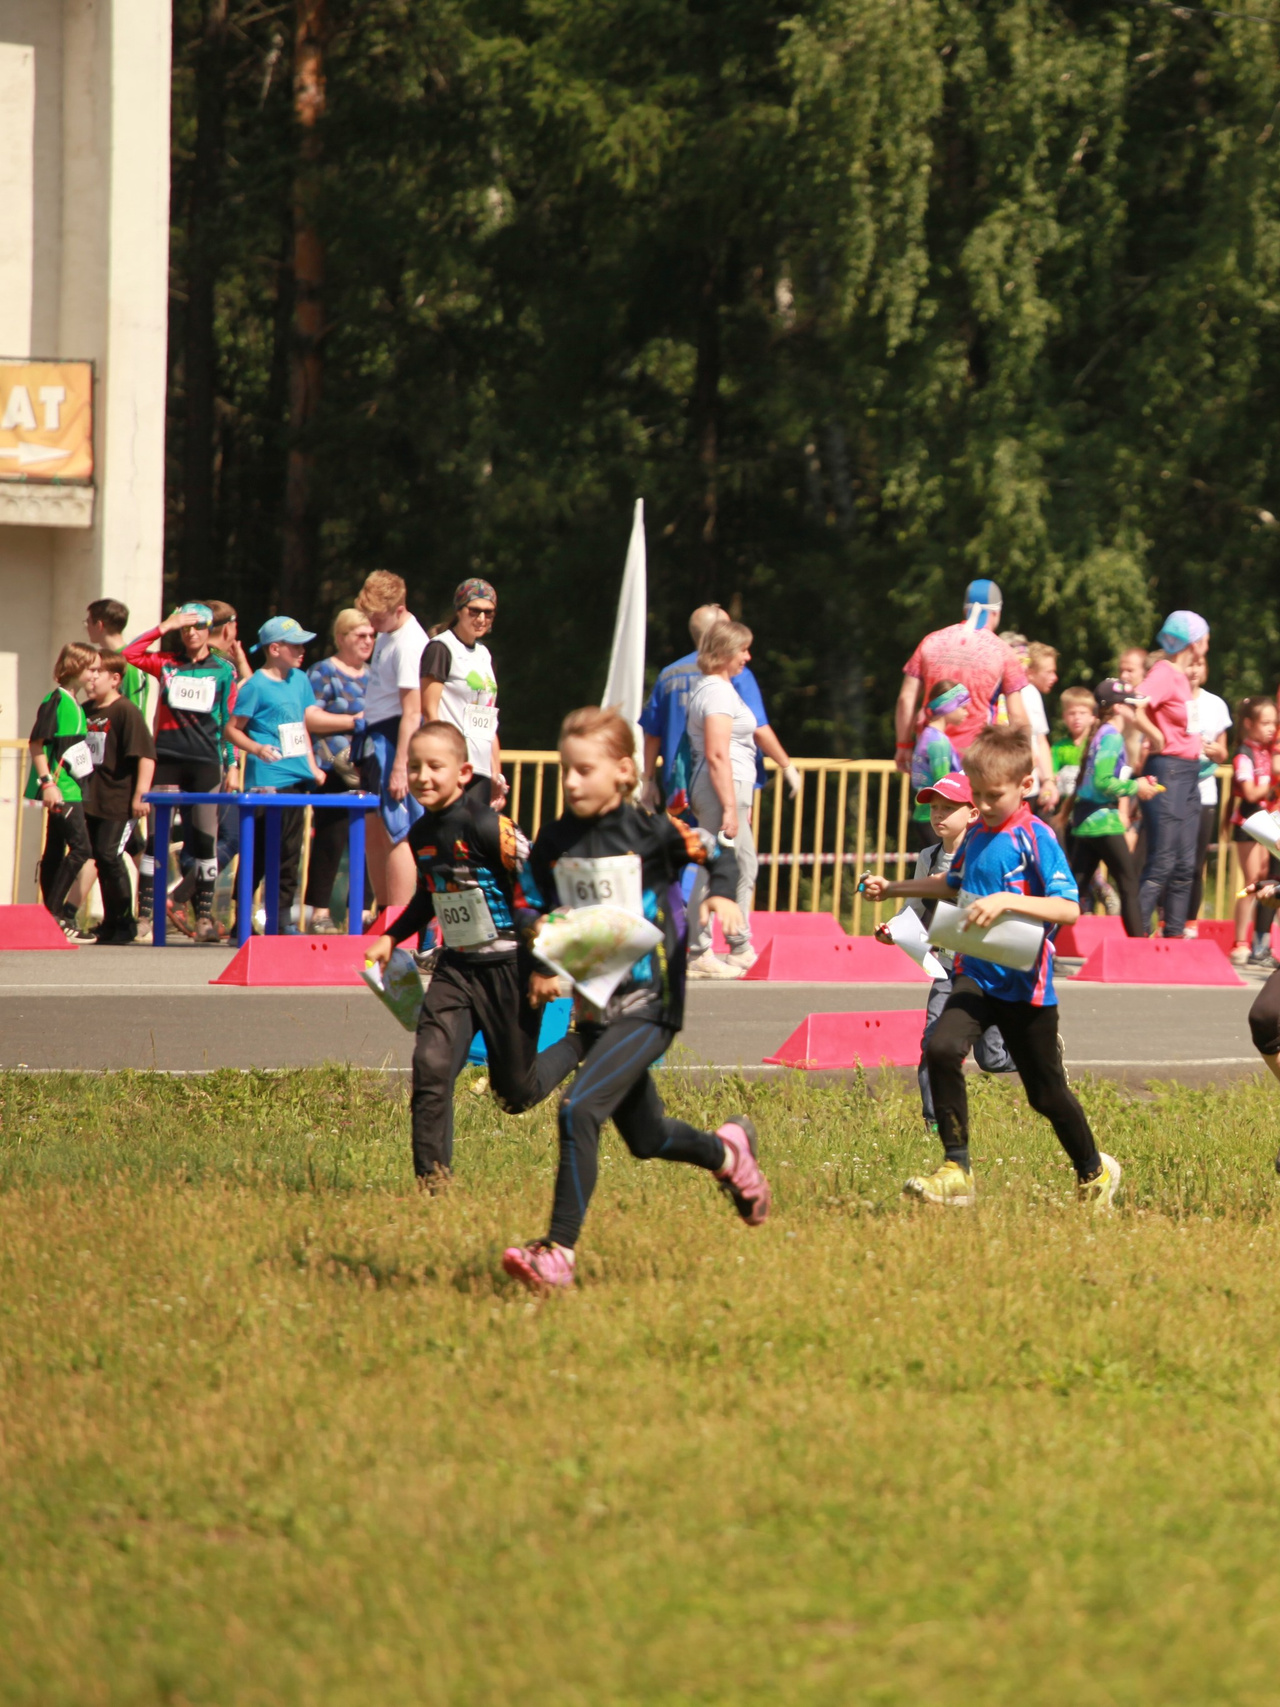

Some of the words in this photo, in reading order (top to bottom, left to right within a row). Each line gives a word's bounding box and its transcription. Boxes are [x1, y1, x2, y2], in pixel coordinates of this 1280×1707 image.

[1, 385, 66, 431] AT
[180, 688, 201, 700] 901
[472, 716, 489, 729] 902
[576, 880, 613, 900] 613
[442, 906, 471, 925] 603
